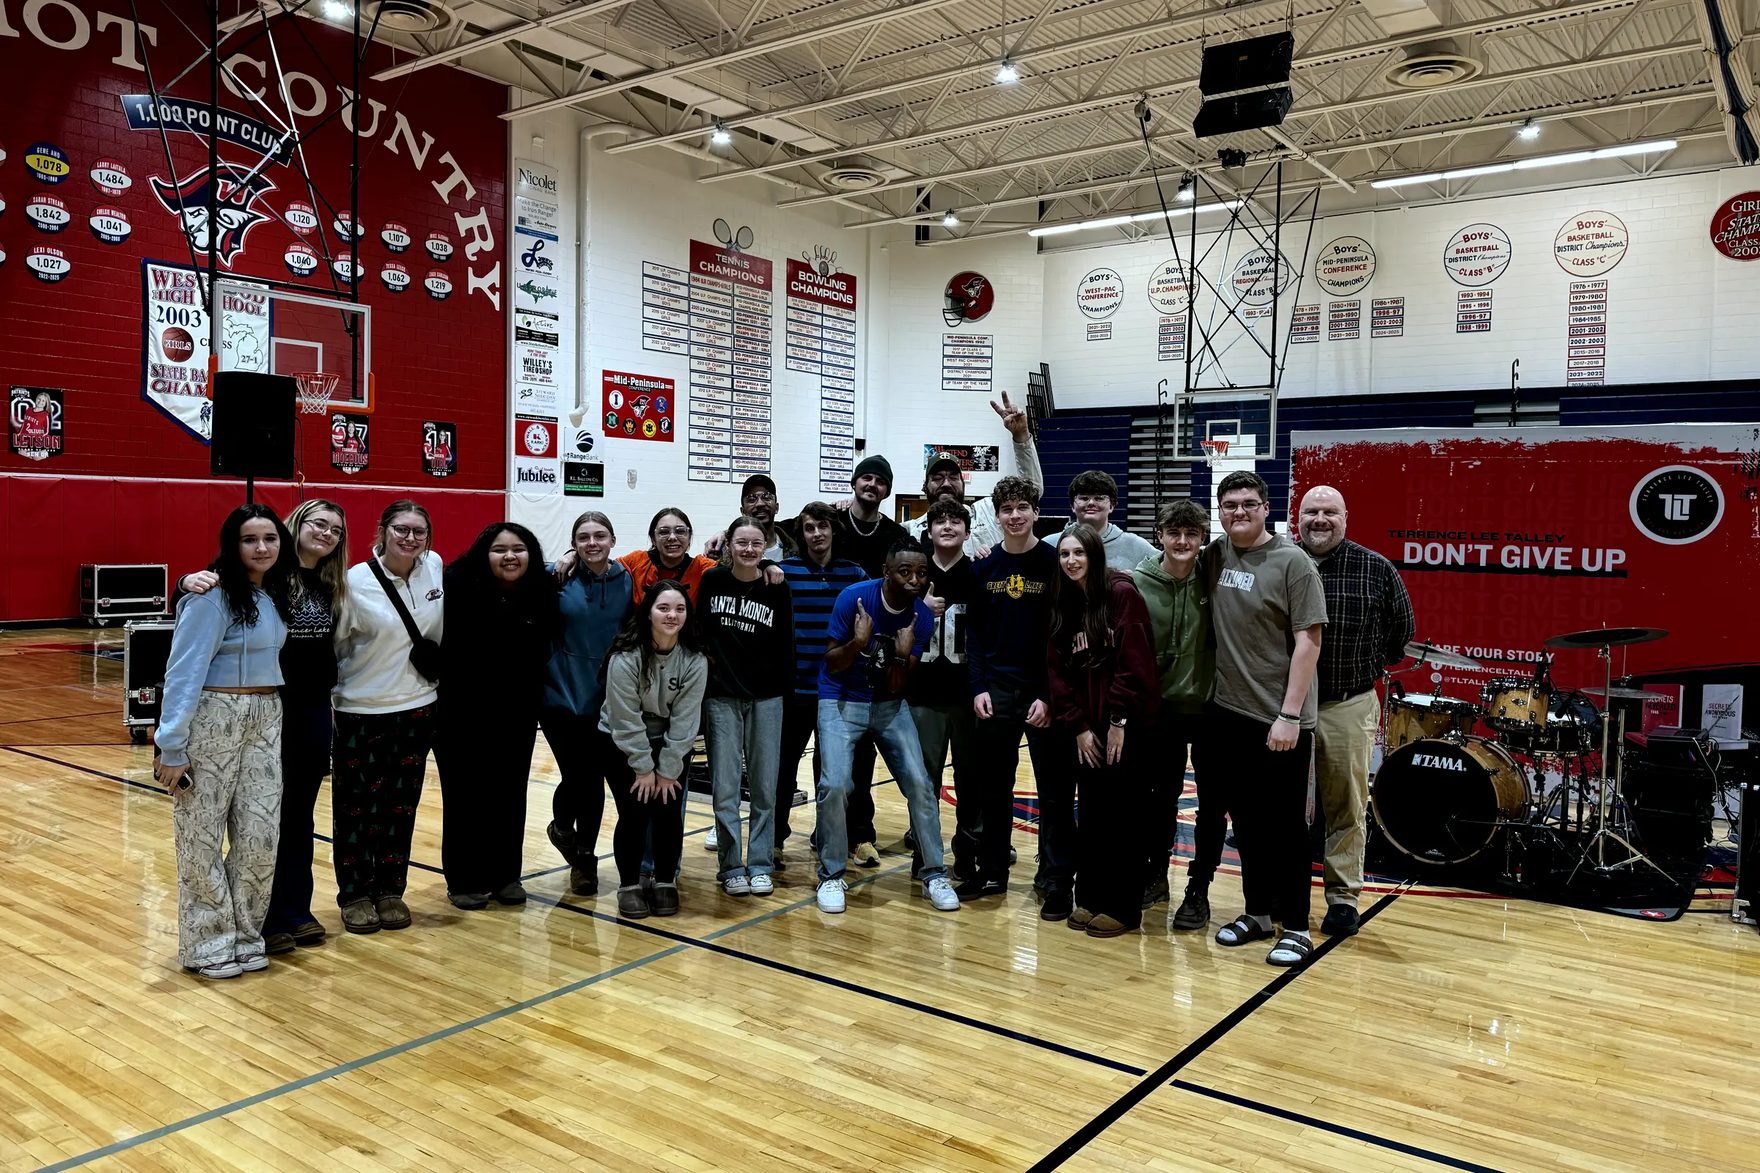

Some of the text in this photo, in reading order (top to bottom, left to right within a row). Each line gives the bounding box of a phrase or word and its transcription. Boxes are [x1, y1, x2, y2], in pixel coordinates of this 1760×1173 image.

[188, 108, 239, 135] PONT
[36, 158, 62, 173] 1,078
[99, 171, 125, 186] 1,484
[220, 53, 500, 311] COUNTRY
[518, 167, 557, 191] Nicolet
[35, 207, 62, 222] 1,842
[293, 213, 310, 225] 1,120
[99, 219, 123, 233] 1,041
[1577, 219, 1608, 231] BOYS'
[388, 232, 404, 243] 1,107
[1462, 232, 1493, 243] BOYS'
[1567, 231, 1615, 242] BASKETBALL
[47, 248, 64, 258] OLSON
[431, 242, 448, 253] 1,038
[1333, 243, 1361, 255] BOYS'
[1455, 244, 1500, 255] BASKETBALL
[1557, 240, 1625, 253] DISTRICT Champions
[36, 257, 62, 271] 1,027
[716, 253, 750, 271] TENNIS
[1322, 255, 1369, 266] MID-PENINSULA
[1448, 255, 1477, 264] DISTRICT
[1572, 257, 1595, 266] CLASS
[700, 261, 764, 287] CHAMPIONS
[1323, 264, 1368, 275] CONFERENCE
[1458, 267, 1483, 277] CLASS
[388, 272, 405, 283] 1,062
[798, 270, 847, 291] BOWLING
[1089, 274, 1113, 284] BOYS'
[1327, 275, 1365, 288] CHAMPIONS
[431, 280, 446, 292] 1,219
[791, 281, 853, 304] CHAMPIONS
[1085, 286, 1116, 295] WEST-PAC
[152, 289, 196, 306] HIGH
[1081, 292, 1119, 301] CONFERENCE
[1160, 298, 1176, 306] CLASS
[1082, 302, 1118, 313] CHAMPIONS
[157, 305, 202, 327] 2003
[242, 352, 258, 364] 27-1
[523, 357, 553, 368] WILLEY'S
[151, 363, 187, 383] STATE
[613, 376, 665, 391] Mid-Peninsula
[517, 467, 556, 484] Jubilee
[1388, 529, 1567, 544] TERRENCE LEE TALLEY
[1403, 542, 1627, 573] DON'T GIVE UP
[710, 595, 774, 628] SANTA MONICA
[720, 616, 756, 633] CALIFORNIA
[1464, 646, 1503, 660] YOUR
[1421, 754, 1463, 772] TAMA
